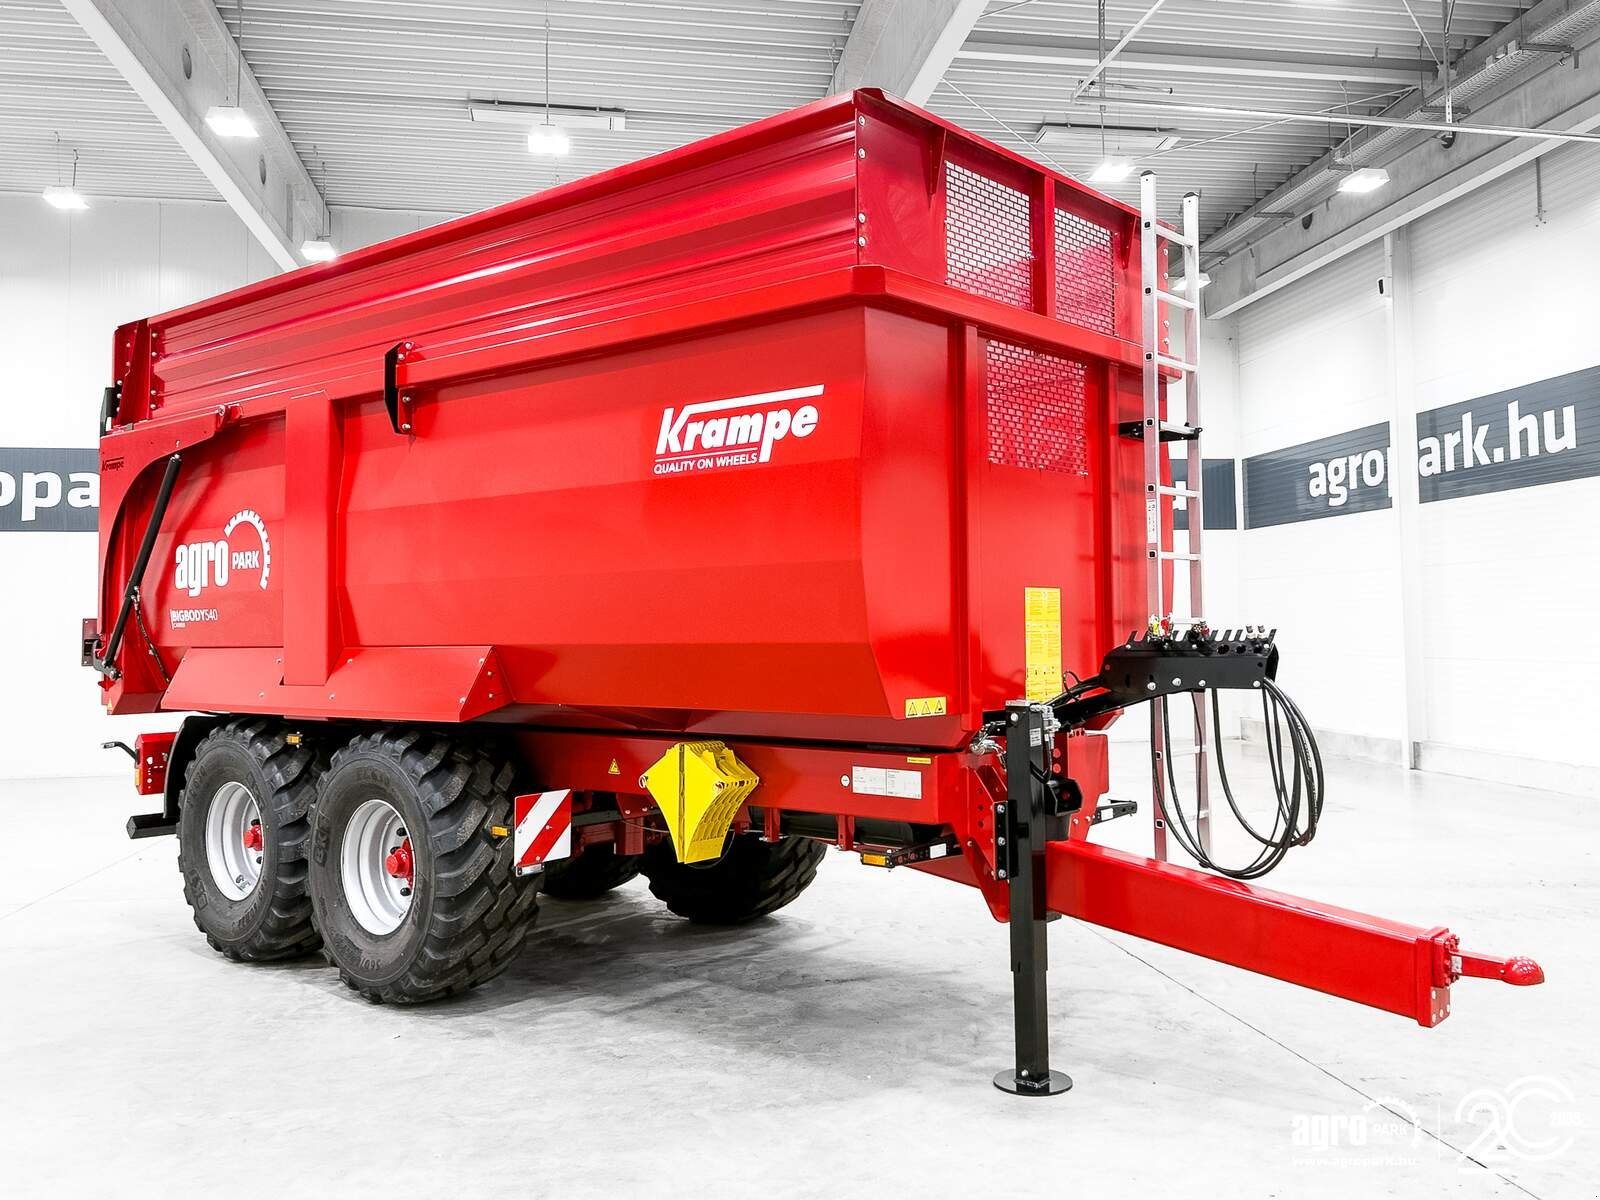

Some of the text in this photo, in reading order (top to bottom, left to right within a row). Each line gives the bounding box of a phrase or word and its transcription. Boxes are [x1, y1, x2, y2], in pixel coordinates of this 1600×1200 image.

[655, 384, 825, 463] Krampe
[1308, 400, 1577, 507] agroark.hu
[653, 452, 758, 475] QUALITY ON WHEELS
[175, 540, 260, 597] agro PARK
